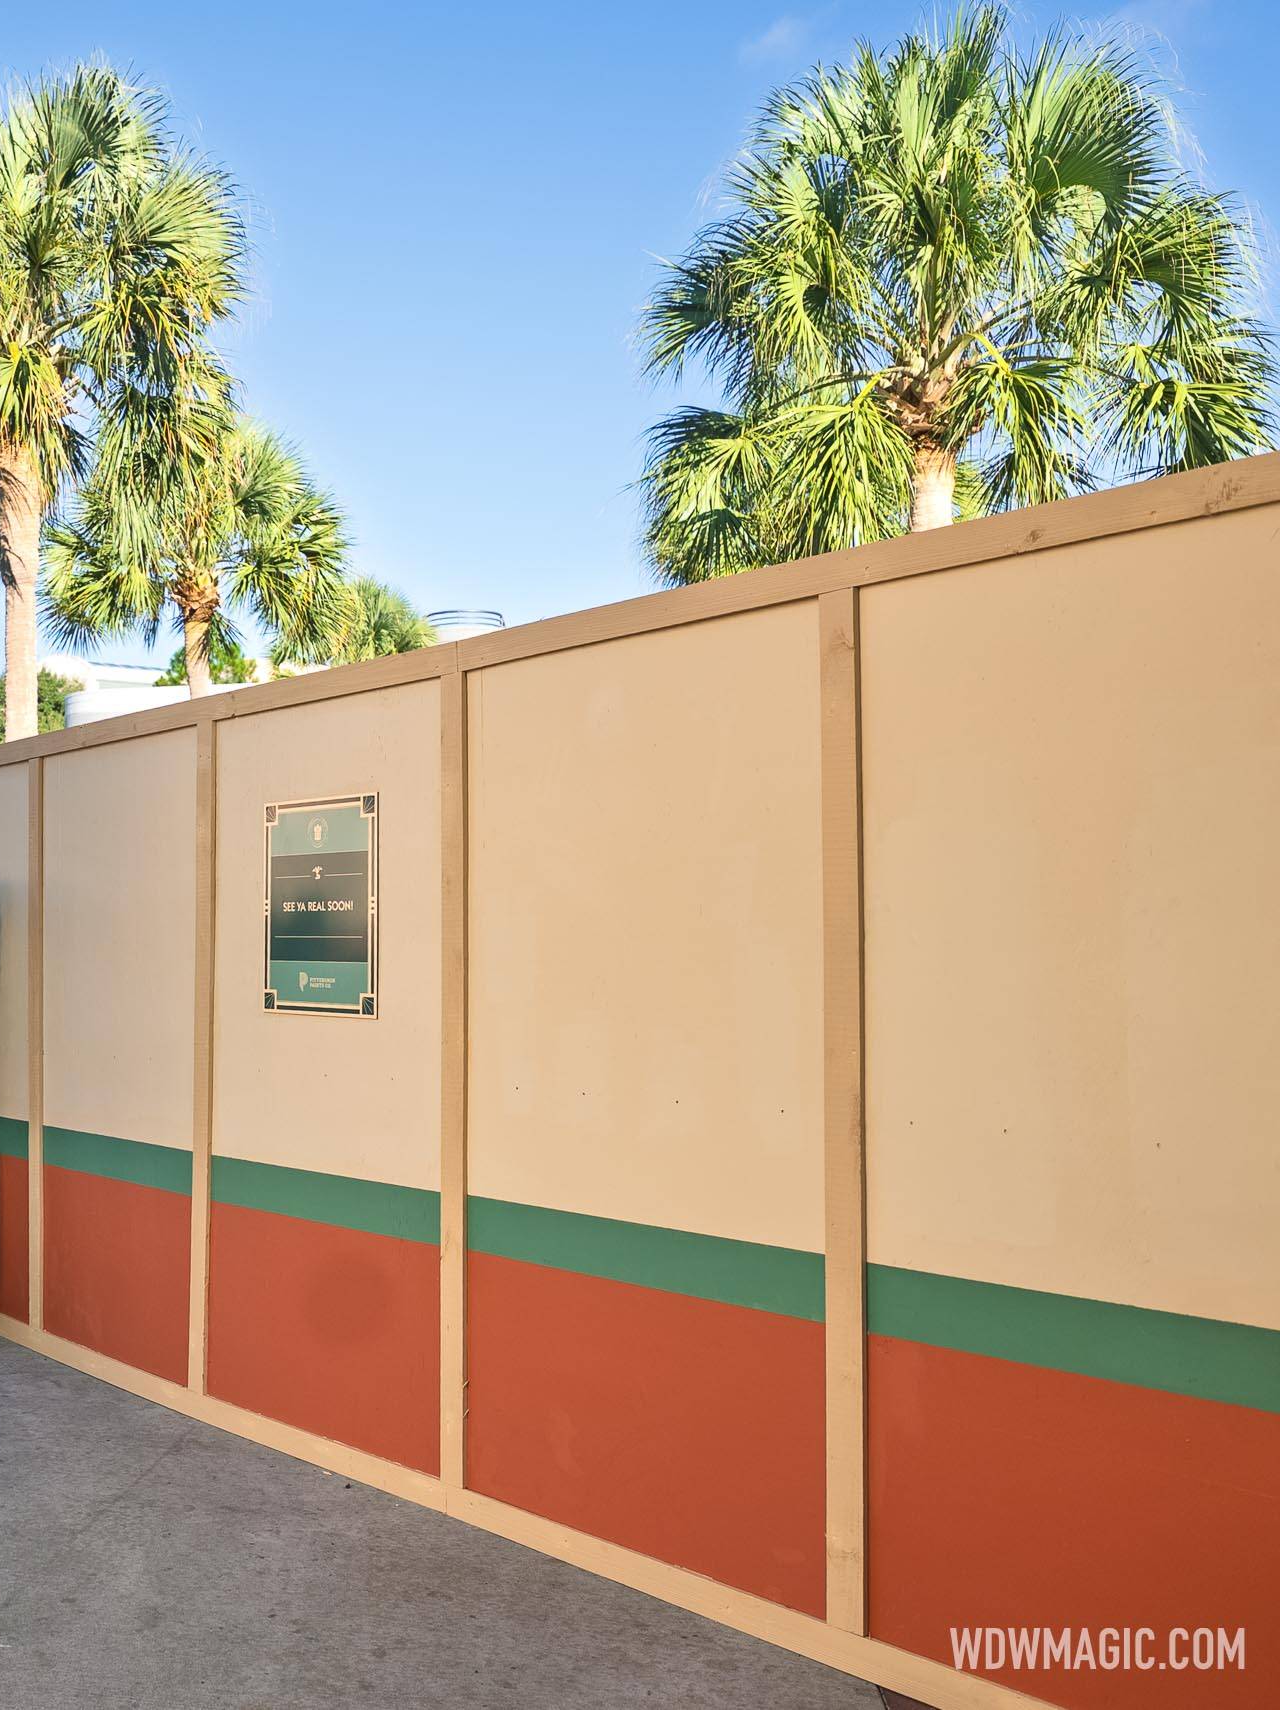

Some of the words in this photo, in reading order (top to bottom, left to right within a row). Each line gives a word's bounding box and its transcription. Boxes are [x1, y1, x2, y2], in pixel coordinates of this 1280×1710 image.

[282, 901, 296, 912] SEE
[296, 901, 307, 912] YA
[307, 900, 326, 912] REAL
[327, 899, 354, 911] SOON!
